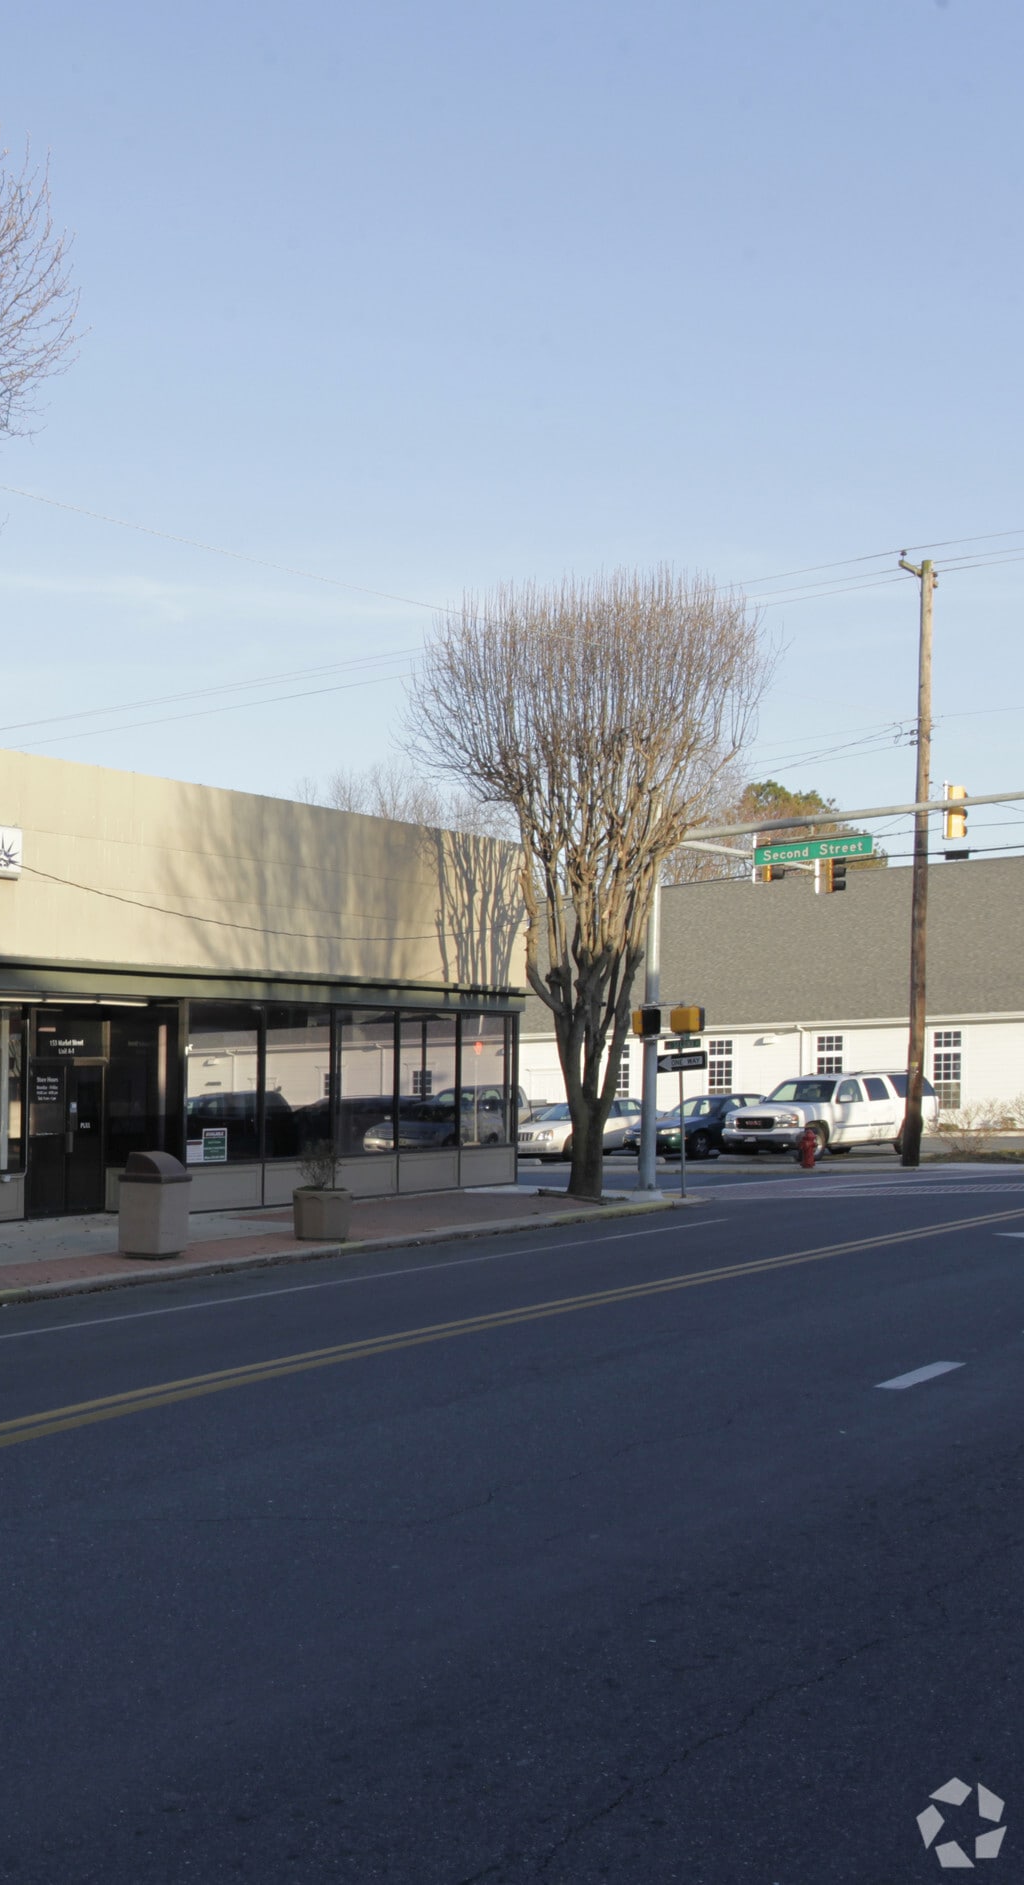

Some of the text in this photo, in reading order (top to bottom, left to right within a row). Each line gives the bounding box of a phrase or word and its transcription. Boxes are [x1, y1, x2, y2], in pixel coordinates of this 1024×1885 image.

[763, 841, 863, 861] Second Street
[671, 1057, 700, 1067] ONE WAY
